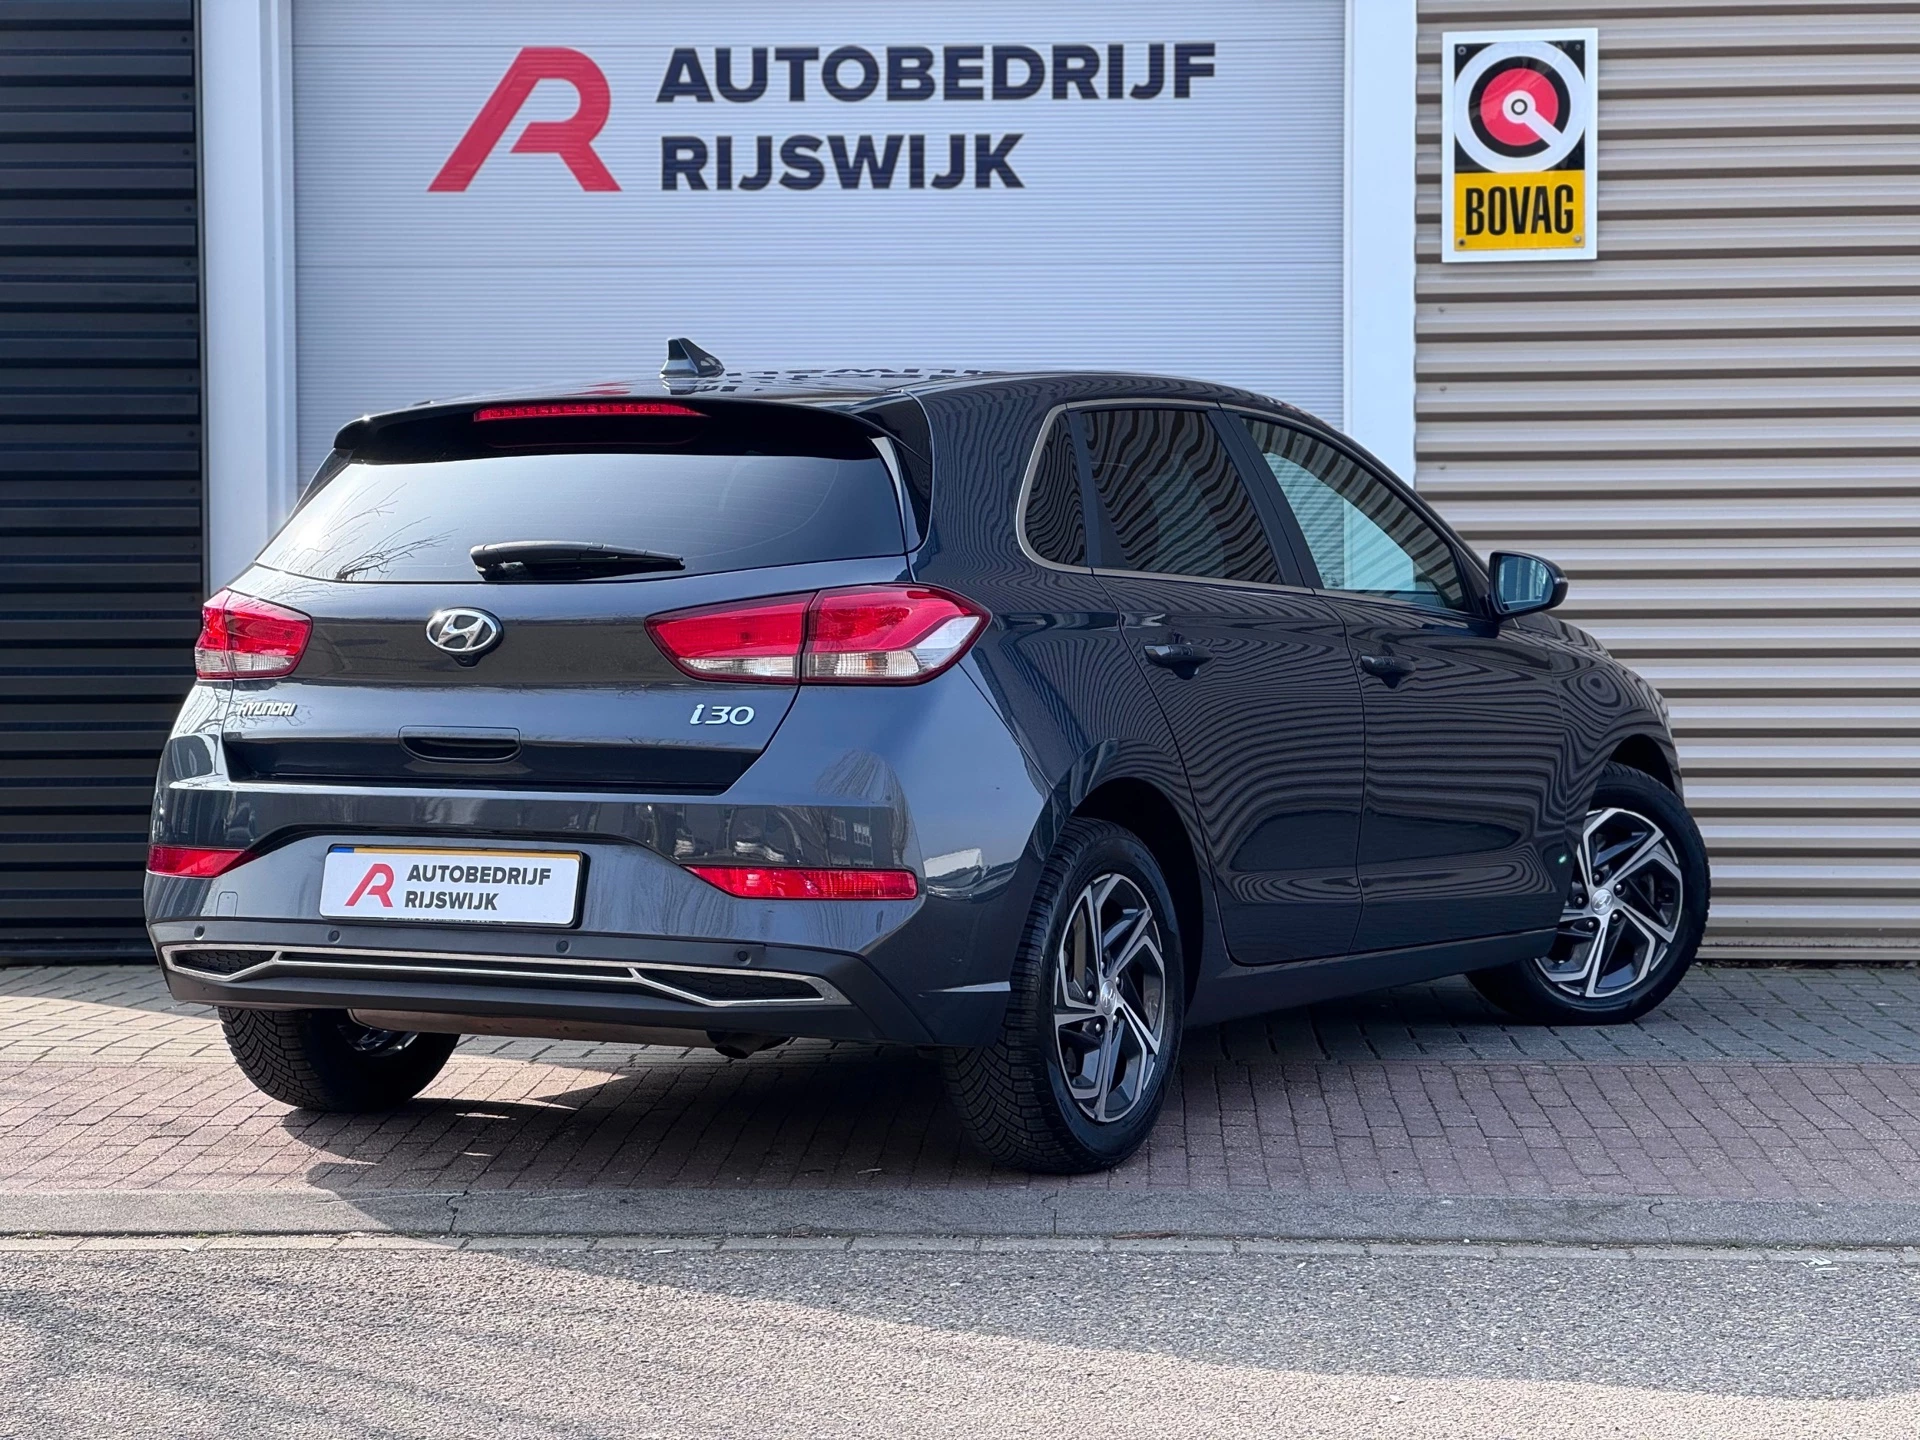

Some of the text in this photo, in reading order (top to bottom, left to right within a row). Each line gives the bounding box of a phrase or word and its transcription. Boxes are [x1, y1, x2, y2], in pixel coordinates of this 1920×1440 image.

[657, 43, 1215, 103] AUTOBEDRIJF
[661, 133, 1025, 191] RIJSWIJK
[1465, 185, 1574, 235] BOVAG
[237, 702, 297, 716] HYUNDAI
[690, 703, 755, 725] i30
[407, 864, 552, 886] AUTOBEDRIJF
[404, 890, 499, 911] RIJSWIJK
